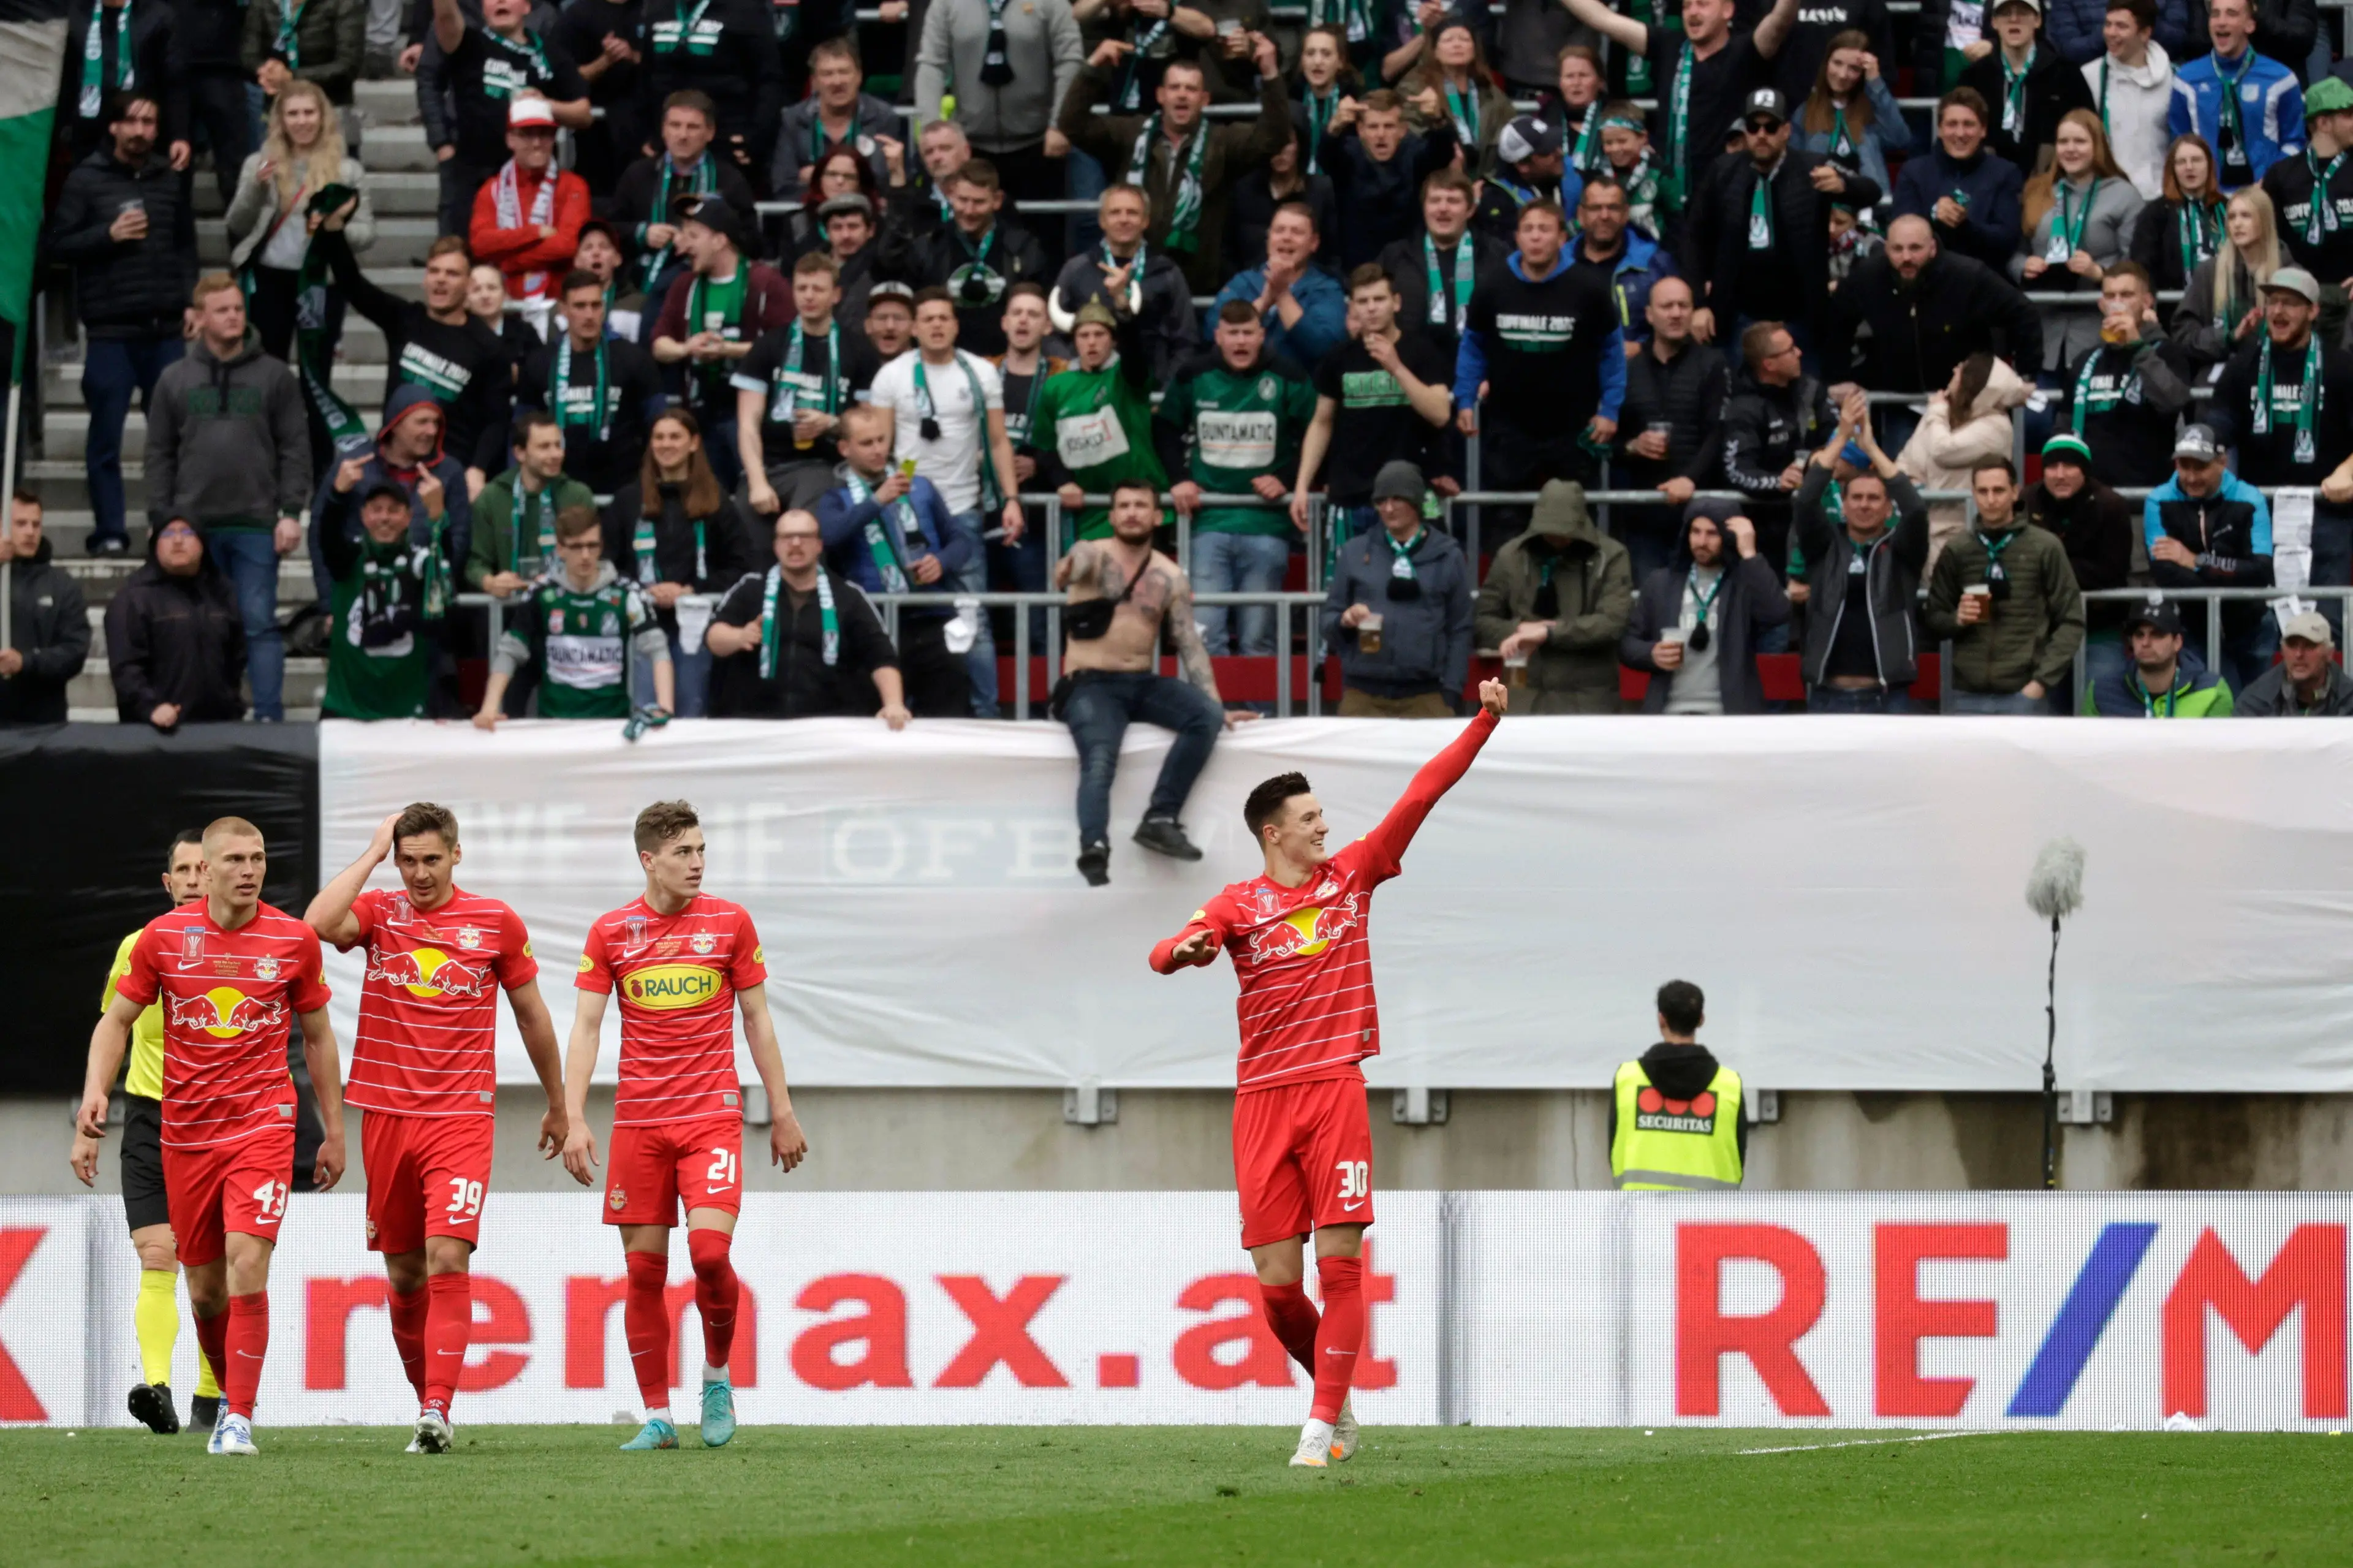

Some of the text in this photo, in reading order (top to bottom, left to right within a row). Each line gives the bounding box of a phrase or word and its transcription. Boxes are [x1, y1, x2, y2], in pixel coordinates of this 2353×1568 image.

[646, 975, 711, 997] RAUCH
[1638, 1115, 1712, 1132] SECURITAS
[707, 1147, 736, 1184] 21
[1336, 1161, 1368, 1199] 30
[253, 1180, 287, 1217] 43
[446, 1178, 483, 1216] 39
